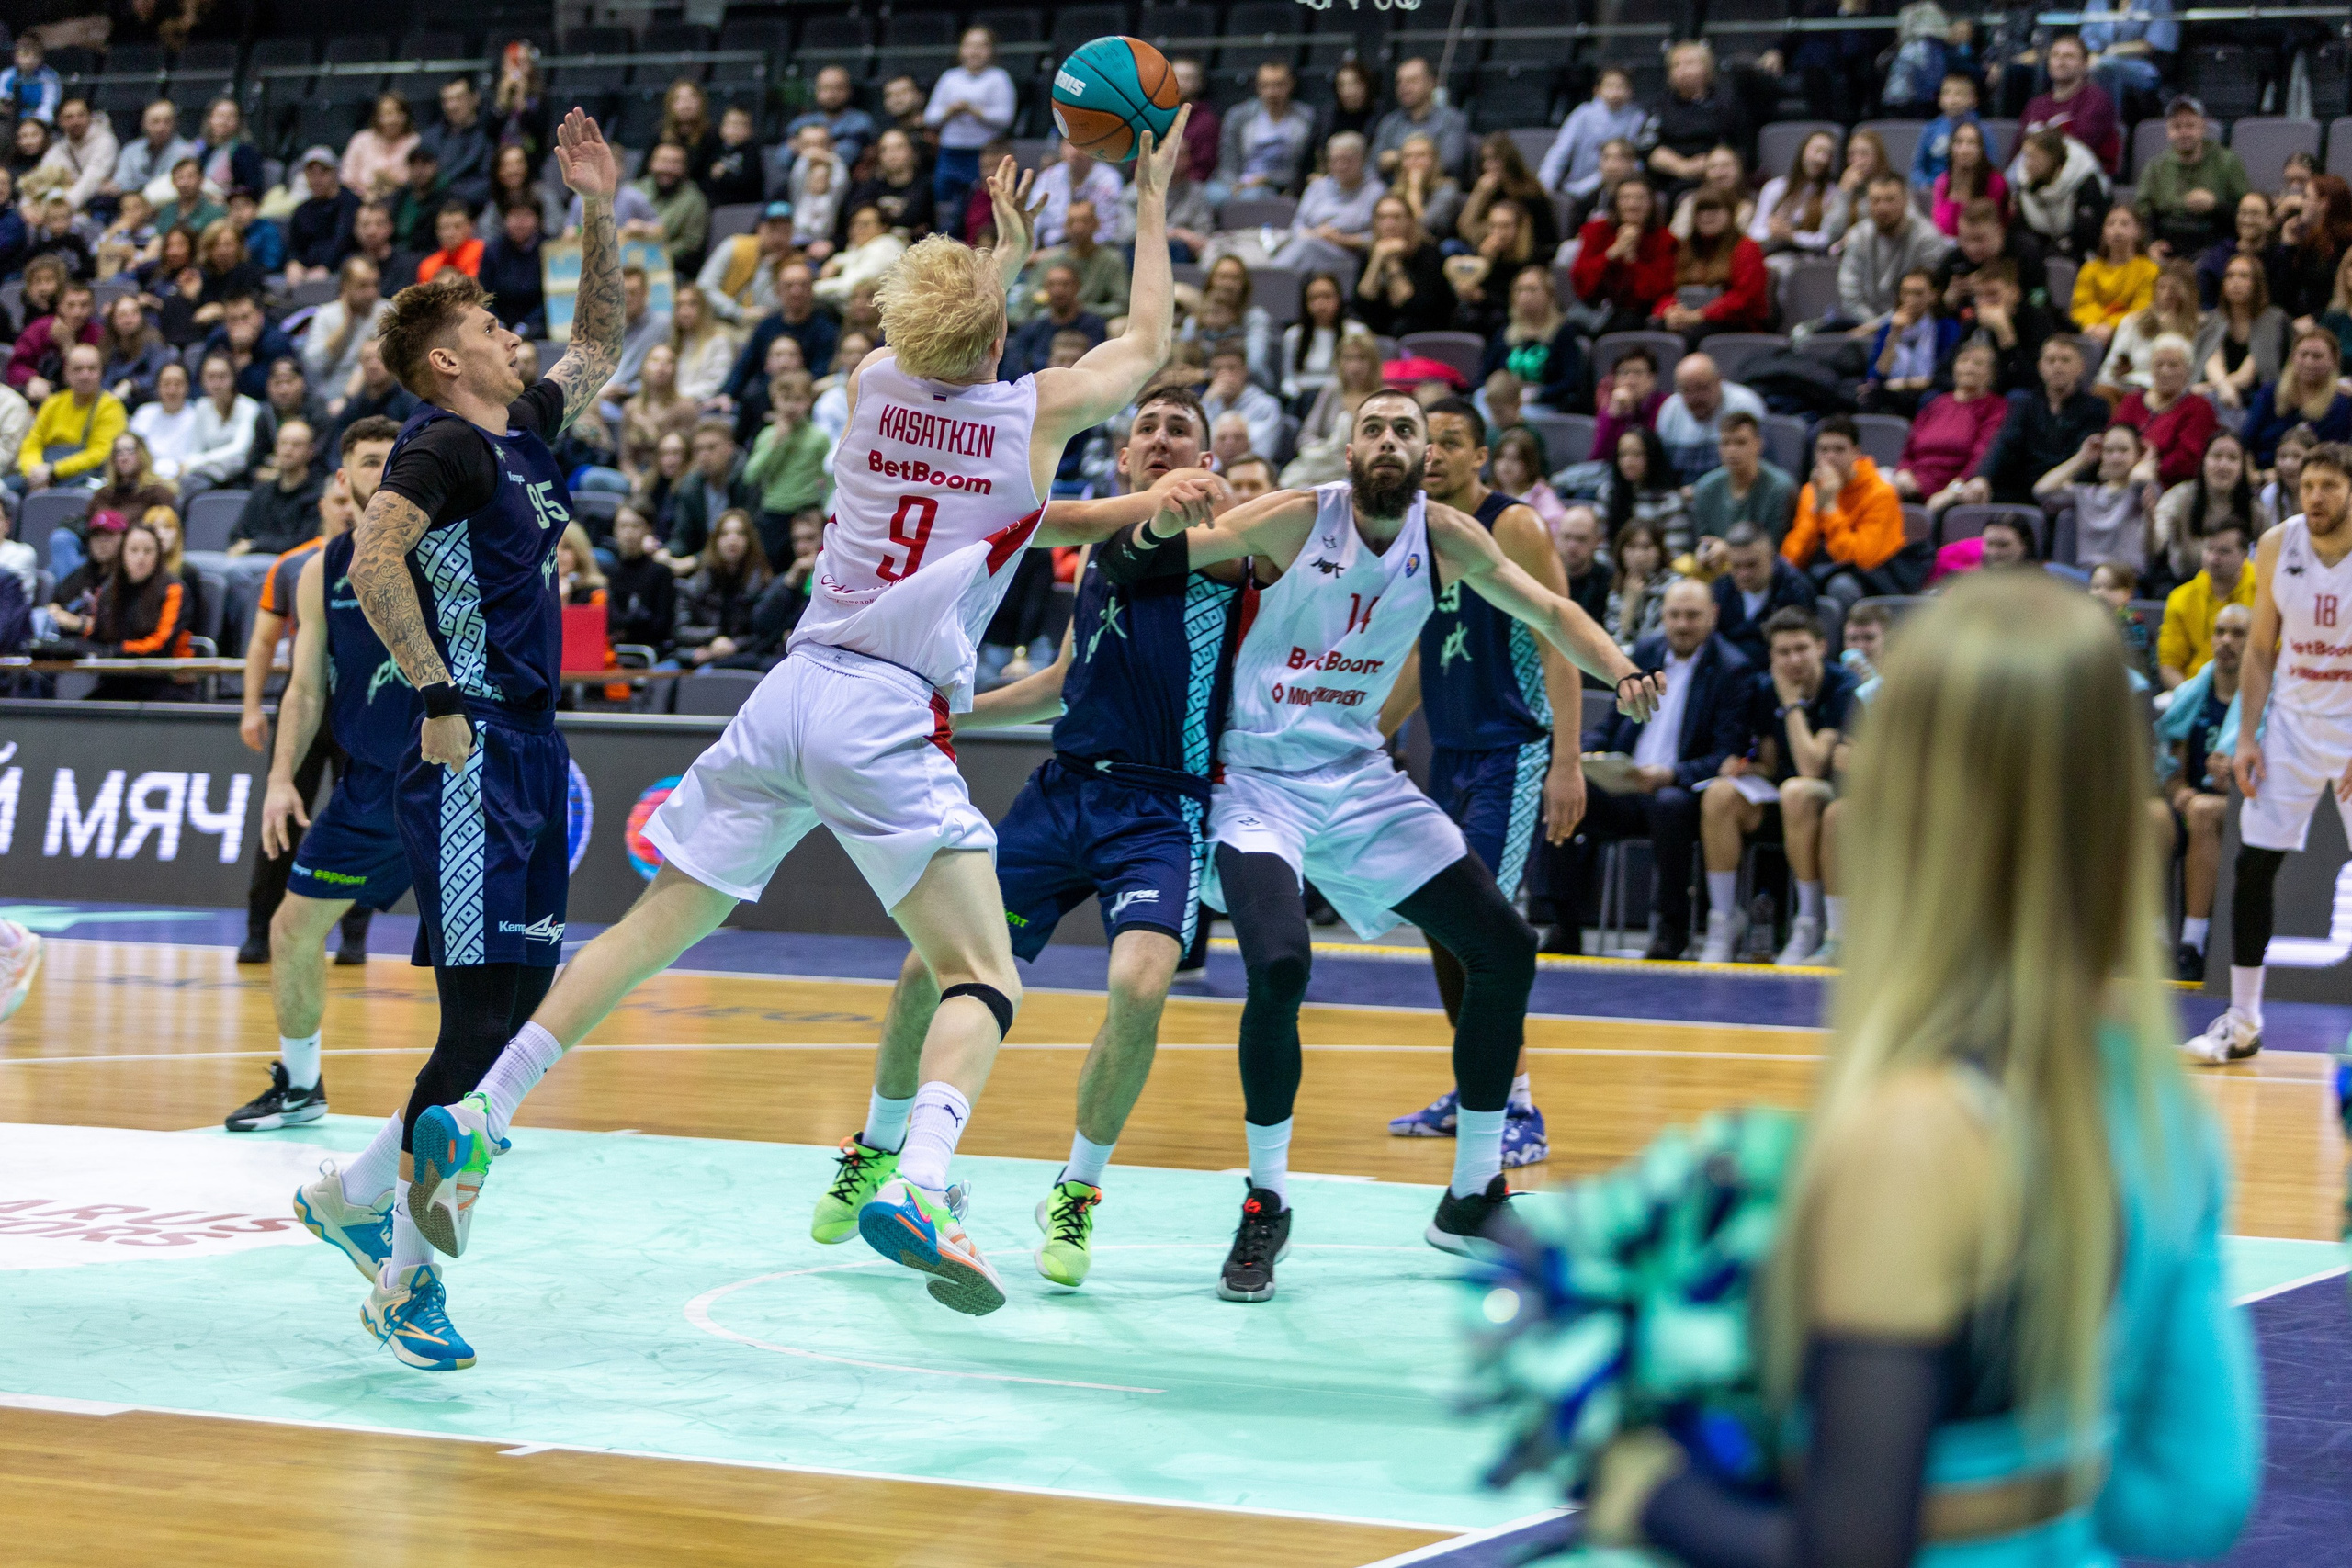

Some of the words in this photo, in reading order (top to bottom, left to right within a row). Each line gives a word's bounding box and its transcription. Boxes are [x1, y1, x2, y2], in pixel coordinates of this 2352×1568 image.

[878, 404, 996, 458] KASATKIN
[868, 449, 992, 495] BetBoom
[526, 480, 570, 529] 95
[876, 494, 939, 583] 9
[2314, 593, 2337, 627] 18
[42, 767, 253, 863] МЯЧ
